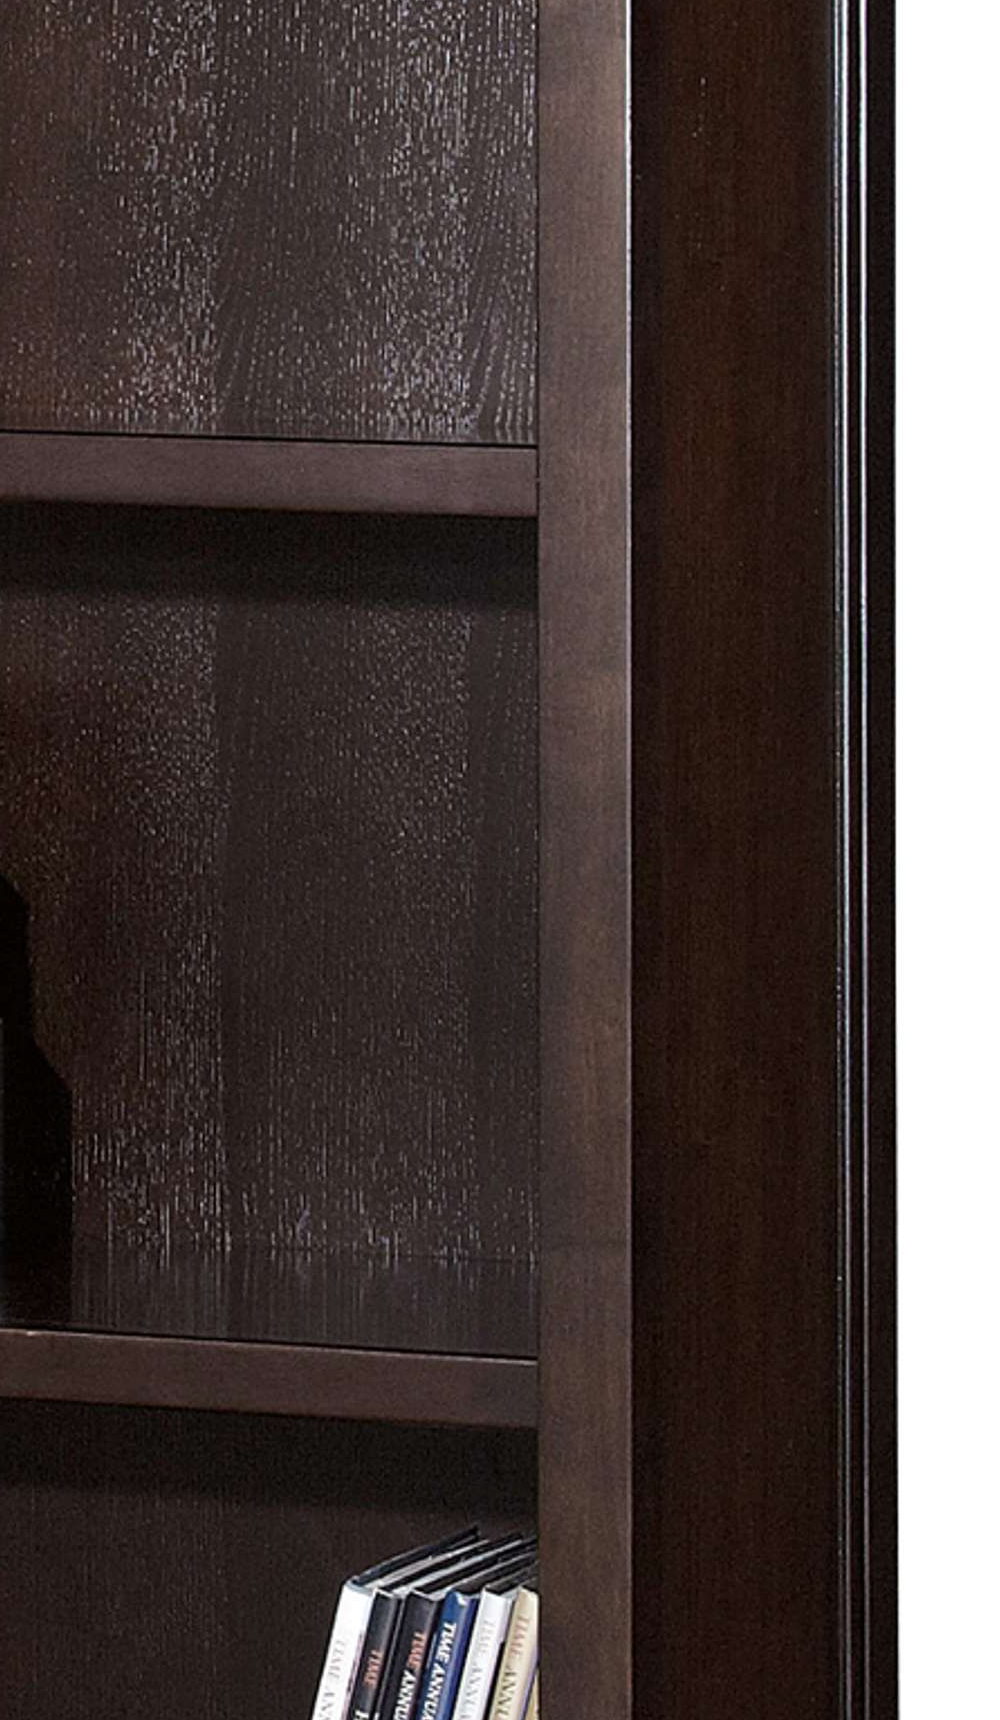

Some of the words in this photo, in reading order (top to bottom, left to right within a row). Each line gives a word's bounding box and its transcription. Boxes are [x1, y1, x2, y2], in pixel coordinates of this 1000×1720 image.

[406, 1631, 425, 1670] TIME
[435, 1622, 455, 1663] TIME
[509, 1615, 529, 1659] TIME
[362, 1649, 381, 1689] TIME
